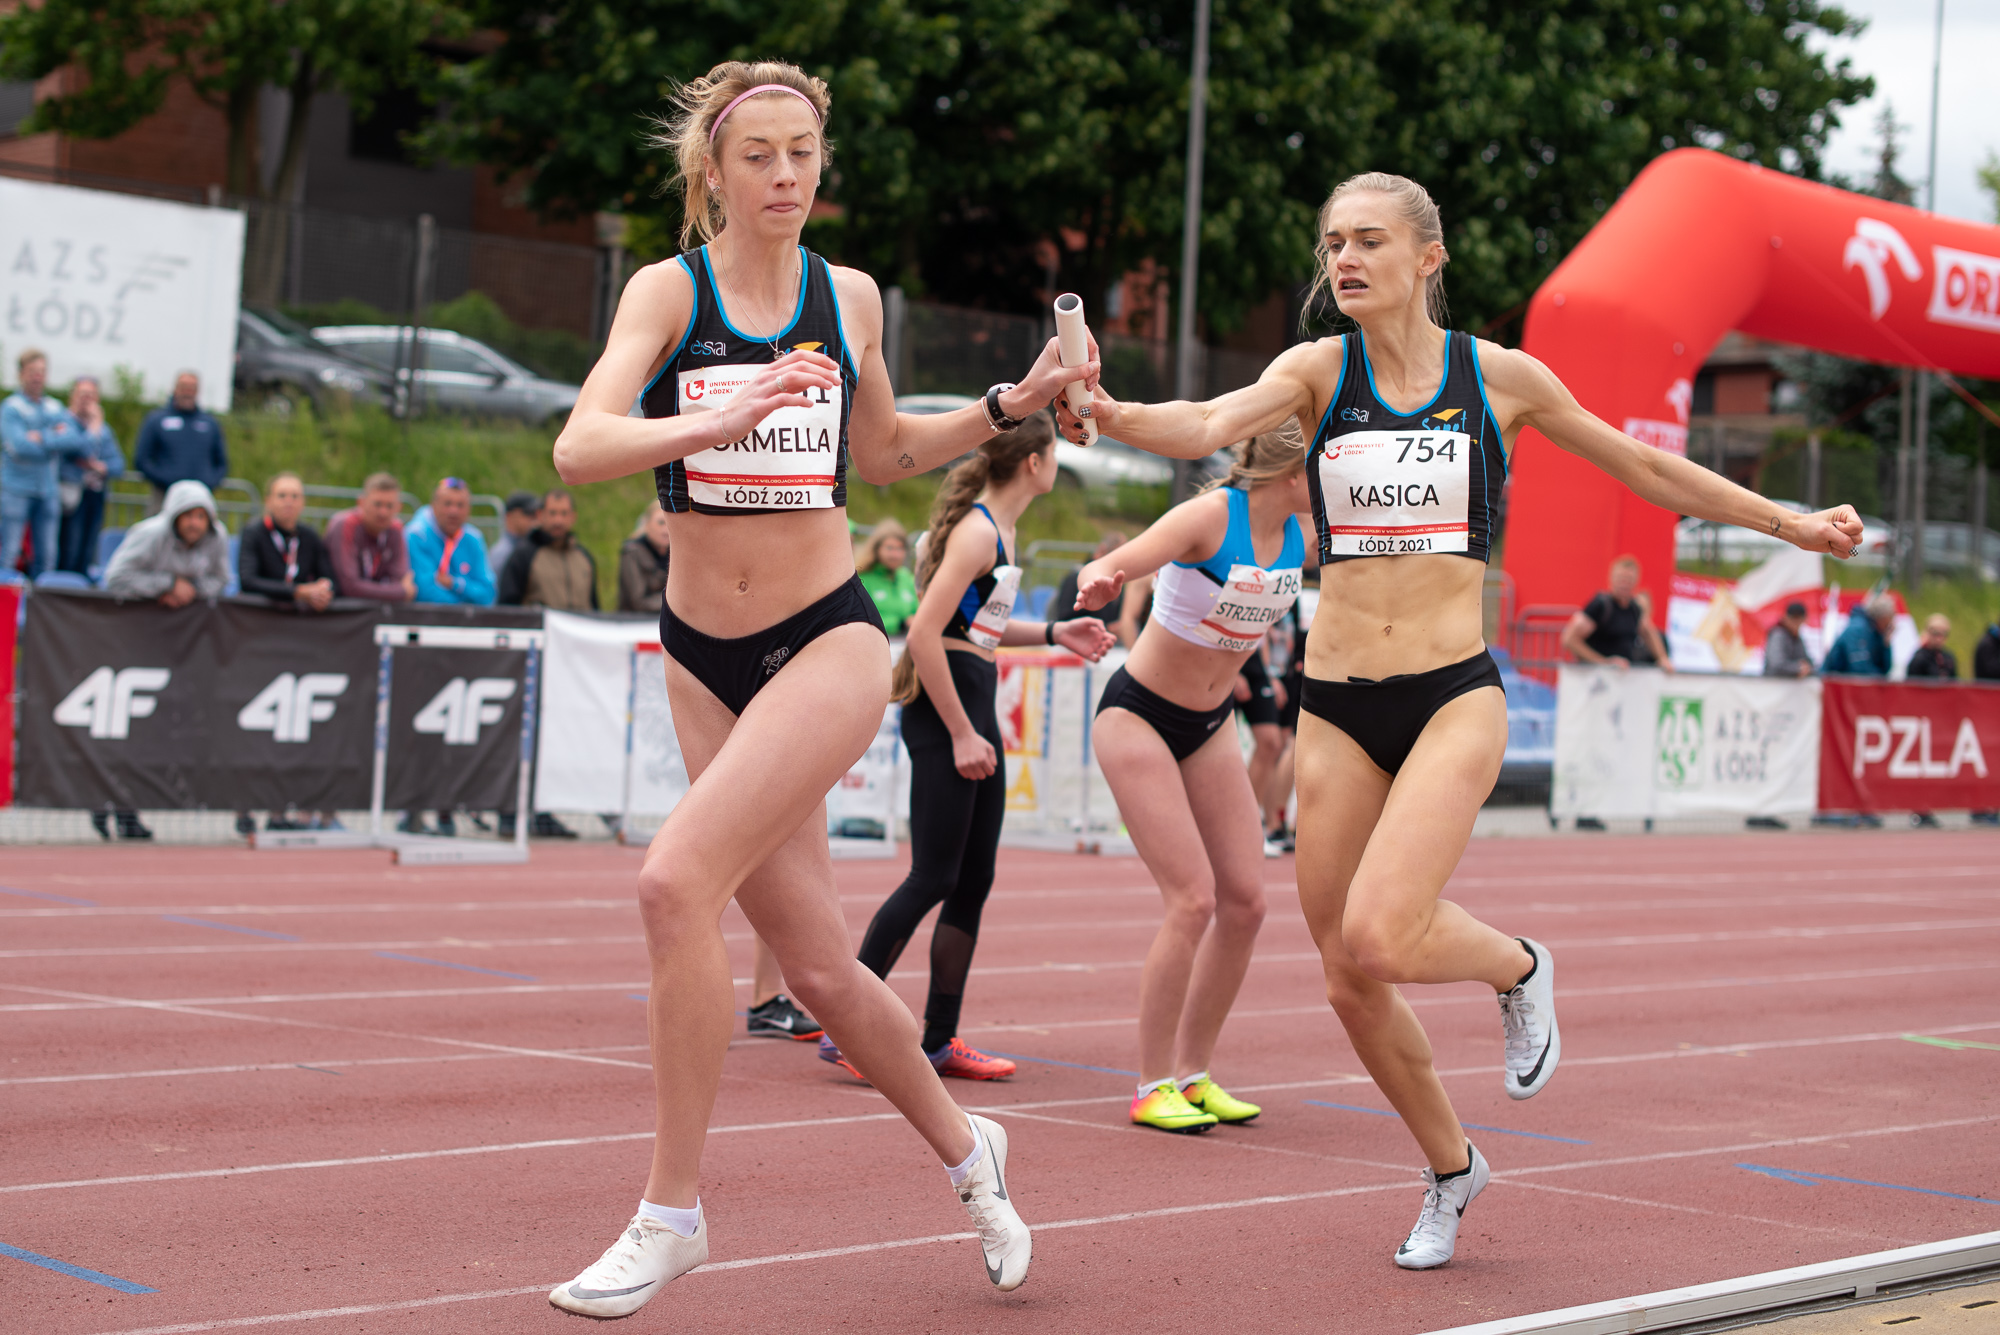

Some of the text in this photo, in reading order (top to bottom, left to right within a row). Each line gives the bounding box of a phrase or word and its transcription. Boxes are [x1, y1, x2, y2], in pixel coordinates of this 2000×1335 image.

[11, 238, 109, 284] AZS
[709, 387, 733, 395] ŁÓDZKI
[1396, 437, 1457, 463] 754
[725, 486, 811, 505] ŁÓDŹ 2021
[1349, 484, 1440, 507] KASICA
[1359, 536, 1432, 552] ŁÓDŹ 2021
[53, 666, 171, 739] 4F
[238, 672, 349, 742] 4F
[413, 677, 518, 745] 4F
[1713, 709, 1760, 741] AZS
[1853, 714, 1989, 779] PZLA
